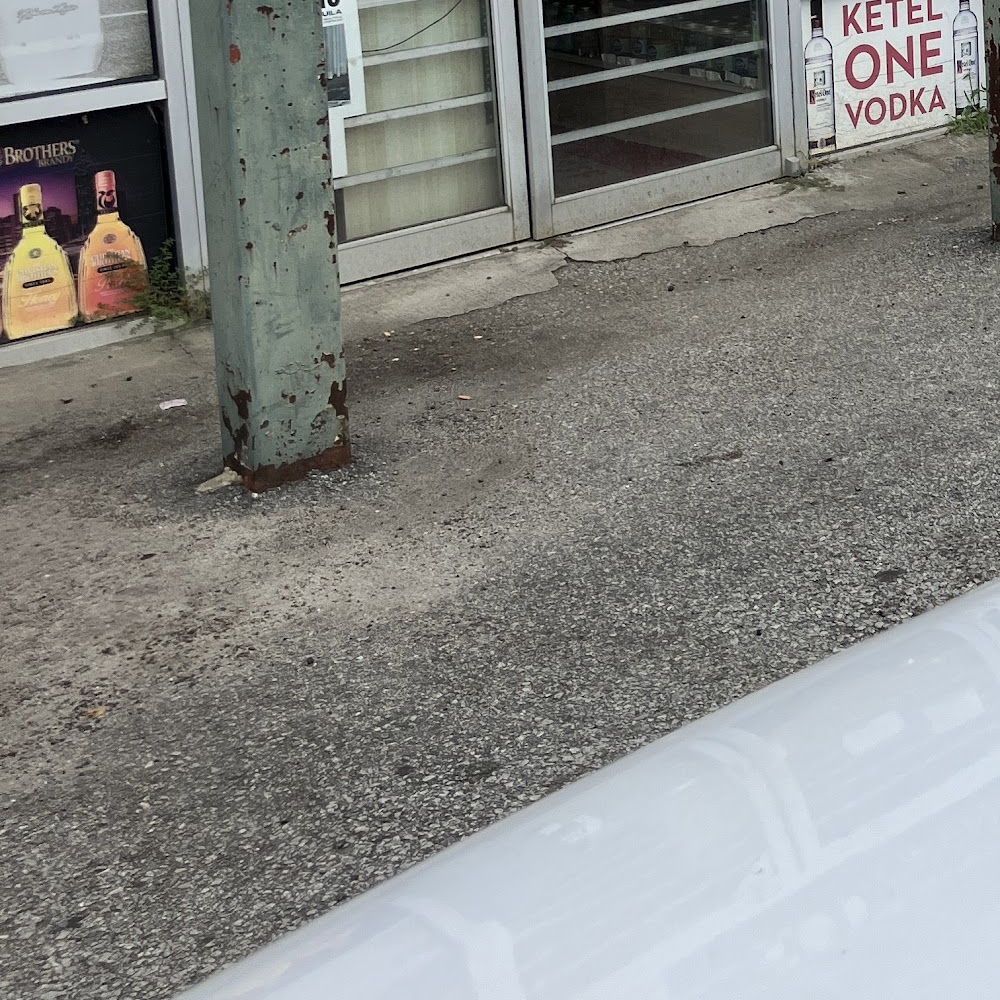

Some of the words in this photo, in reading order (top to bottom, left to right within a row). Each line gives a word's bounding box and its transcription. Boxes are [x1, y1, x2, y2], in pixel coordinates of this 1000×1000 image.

[844, 30, 944, 90] ONE
[844, 85, 946, 129] VODKA
[4, 139, 77, 166] BROTHERS
[38, 155, 74, 169] BRANDY
